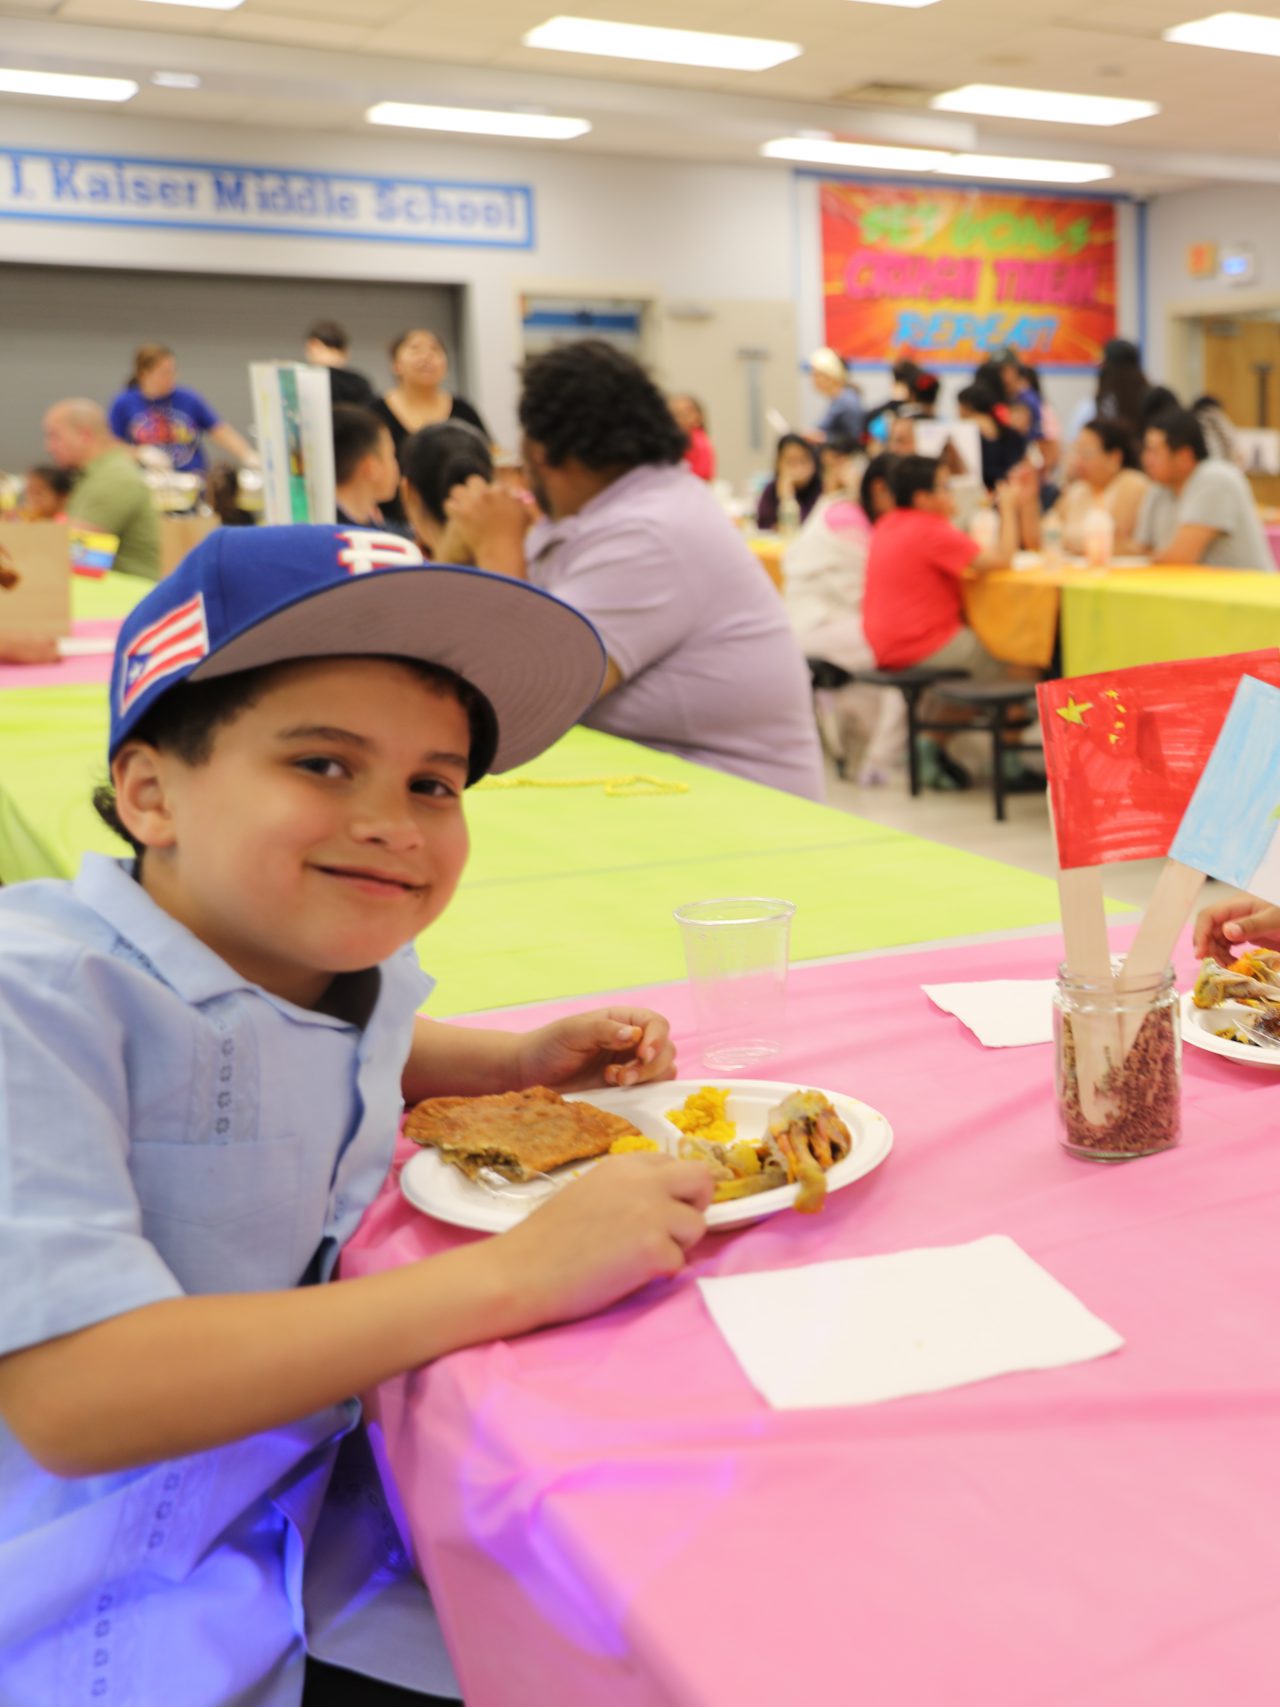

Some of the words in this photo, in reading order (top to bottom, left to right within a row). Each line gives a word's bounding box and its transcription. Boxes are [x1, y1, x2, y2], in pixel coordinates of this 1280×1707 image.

[52, 155, 197, 207] Kaiser
[213, 168, 358, 217] Middle
[374, 182, 518, 230] School
[994, 258, 1098, 308] THEM
